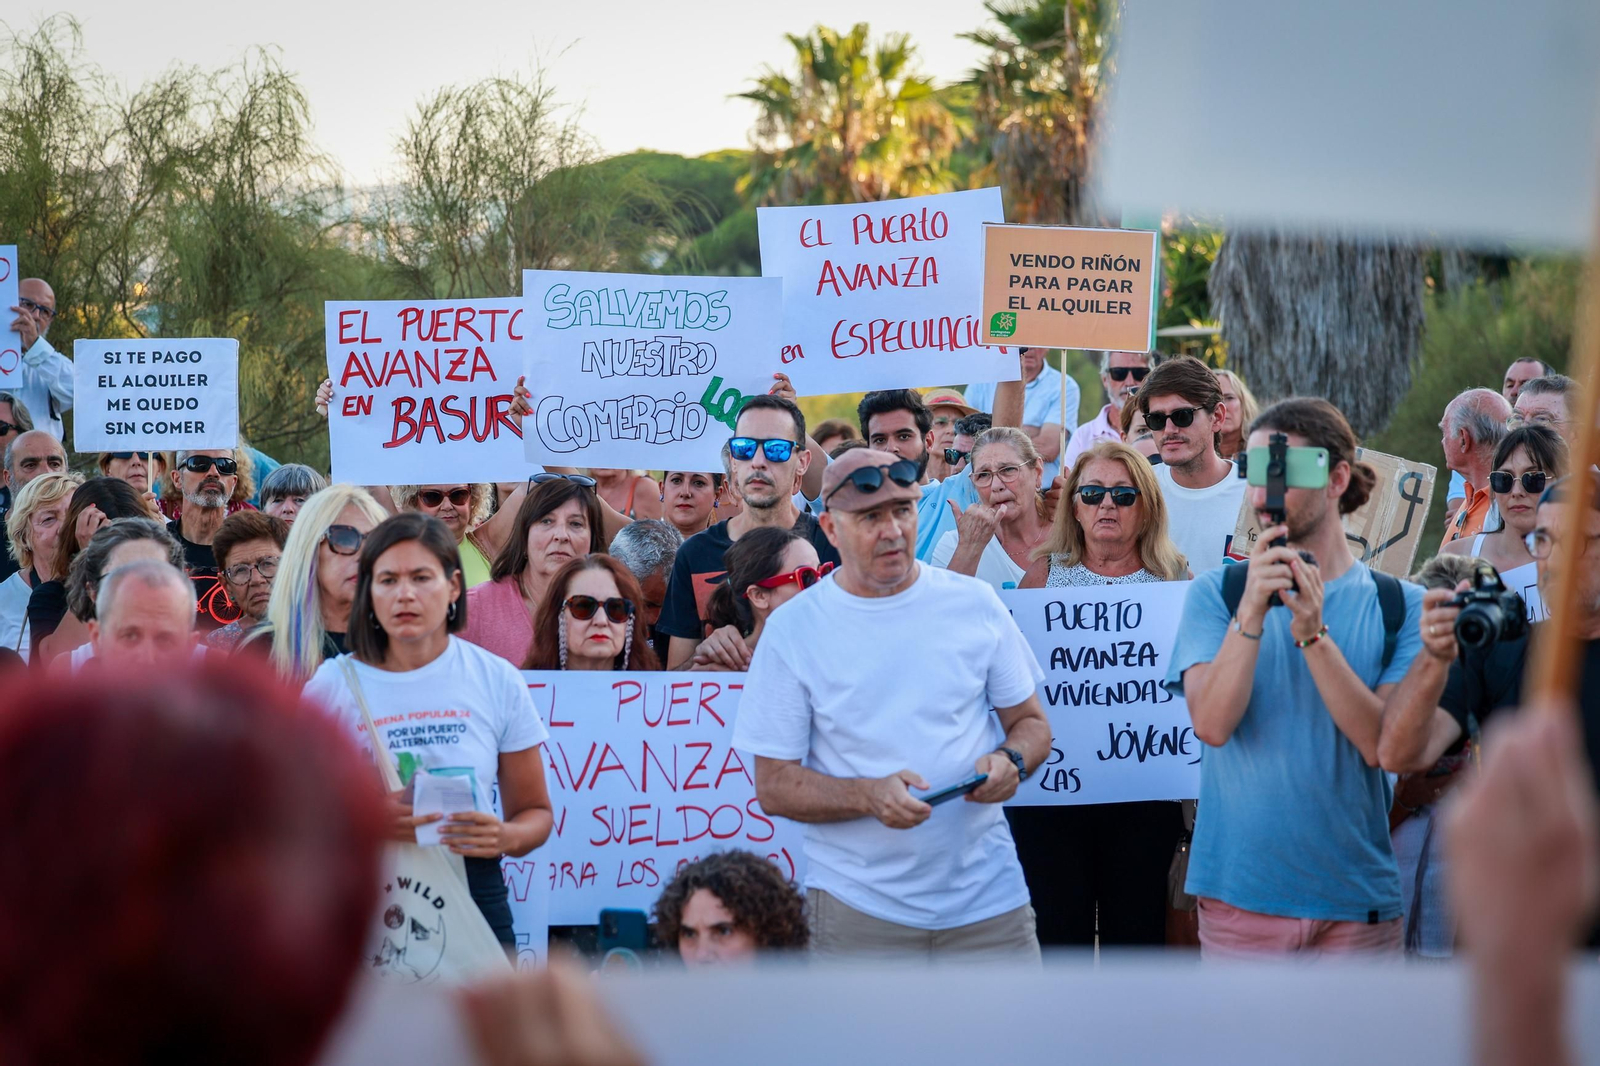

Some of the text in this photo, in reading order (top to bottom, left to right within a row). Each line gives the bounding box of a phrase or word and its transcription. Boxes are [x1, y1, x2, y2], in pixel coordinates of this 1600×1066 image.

[800, 218, 832, 248] EL
[816, 256, 939, 297] AVANZA
[1009, 253, 1141, 272] VENDO RIÑÓN
[1009, 274, 1133, 294] PARA PAGAR
[543, 283, 731, 331] SALVEMOS
[1008, 295, 1132, 316] EL ALQUILER
[339, 309, 382, 344] EL
[104, 350, 202, 364] SI TE PAGO
[339, 346, 498, 389] AVANZA
[581, 336, 717, 379] NUESTRO
[98, 374, 208, 388] EL ALQUILER
[107, 397, 199, 411] ME QUEDO
[105, 421, 205, 435] SIN COMER
[342, 394, 523, 449] EN BASUR
[1044, 599, 1143, 632] PUERTO
[1050, 641, 1159, 672] AVANZA
[612, 680, 744, 728] PUER
[357, 714, 404, 732] VBENA
[408, 709, 457, 721] POPULAR
[387, 723, 467, 738] POR UN PUERTO
[389, 735, 460, 750] ALTERNATIVO
[1039, 767, 1081, 793] LAS
[590, 797, 775, 847] SUELDOS
[617, 857, 660, 888] LOS
[397, 876, 445, 909] WILD
